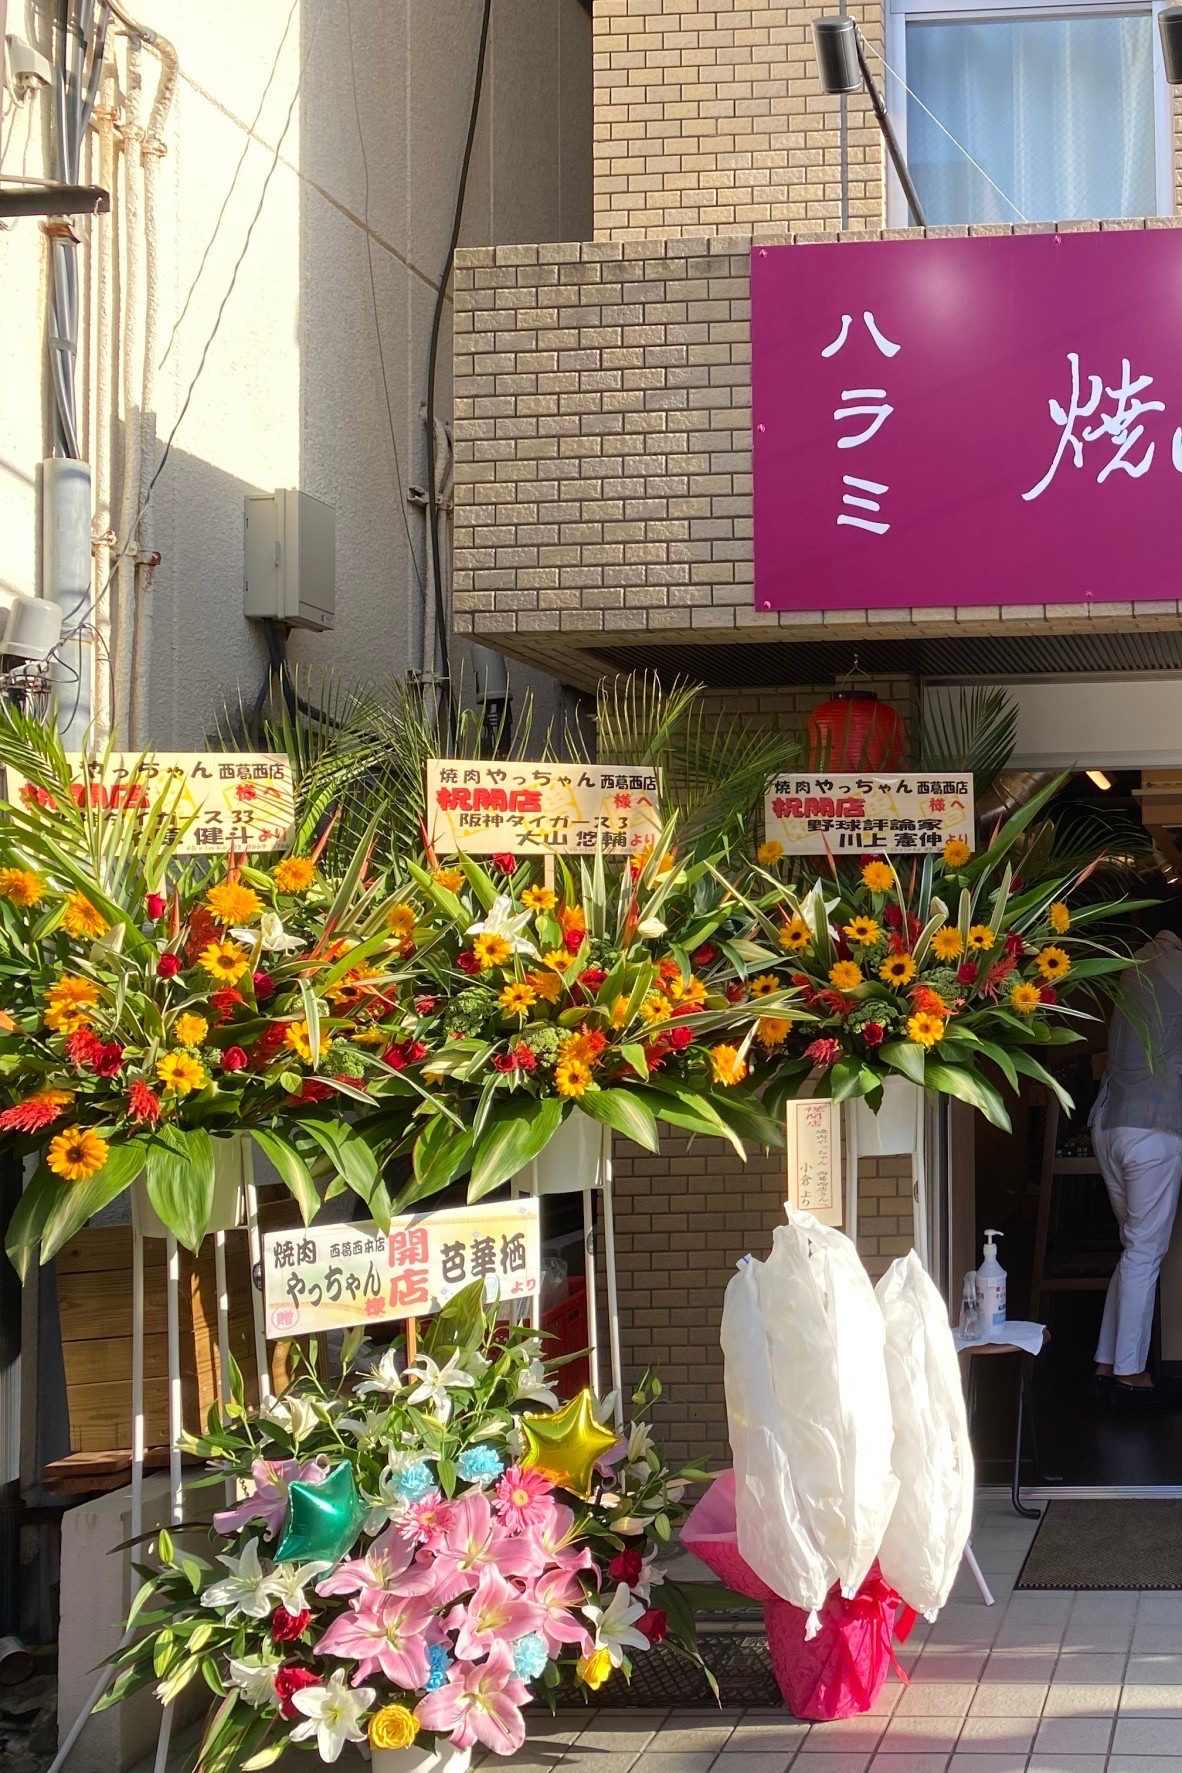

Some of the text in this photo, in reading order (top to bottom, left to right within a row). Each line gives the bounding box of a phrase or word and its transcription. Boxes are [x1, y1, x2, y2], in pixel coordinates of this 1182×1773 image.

[821, 311, 901, 535] ハラミ
[601, 774, 656, 791] 西葛西店
[917, 780, 968, 794] 西葛西店
[436, 786, 543, 812] 祝開店
[772, 797, 866, 818] 祝開店
[808, 819, 942, 832] 野球評論家
[274, 1237, 317, 1269] 焼肉
[388, 1228, 429, 1308] 開店
[287, 1261, 381, 1309] やっちゃん
